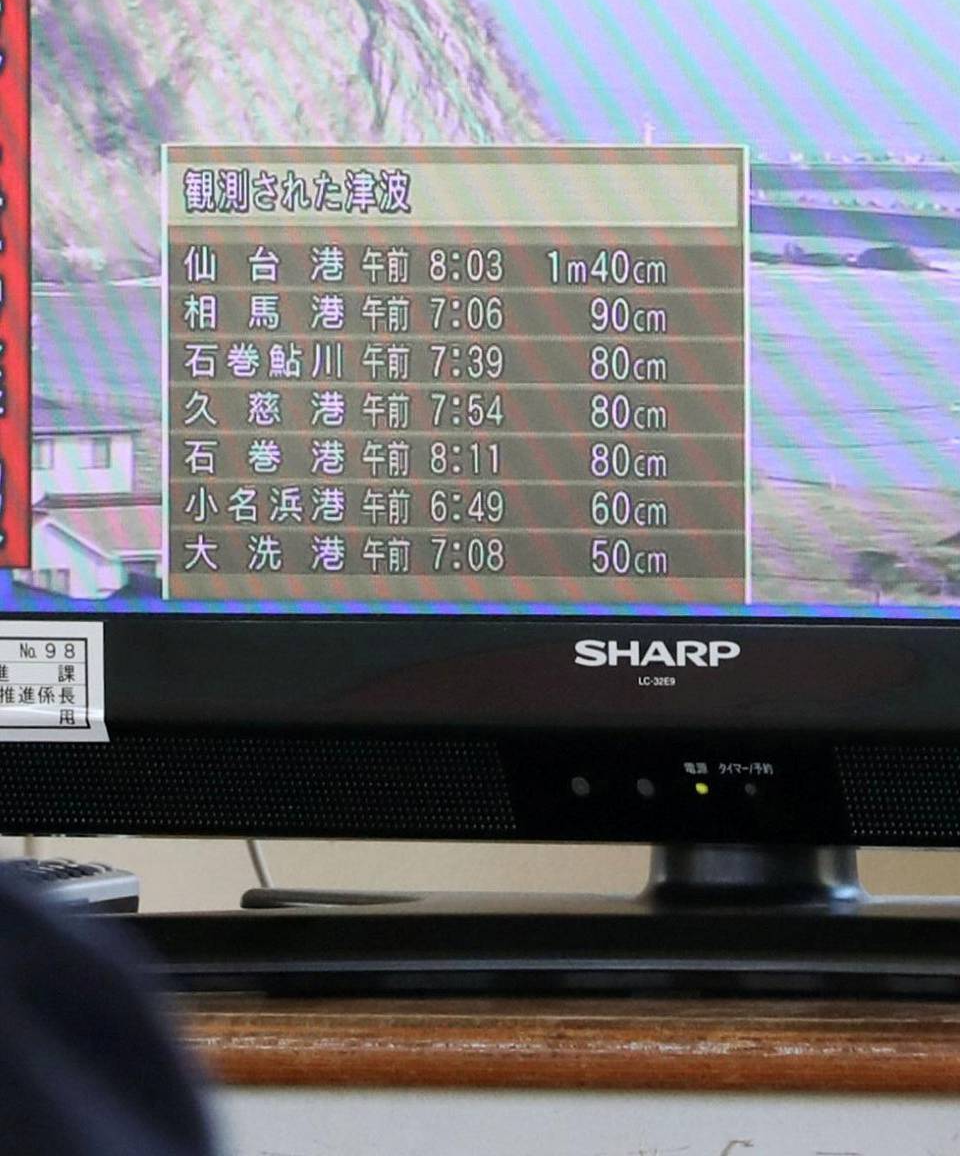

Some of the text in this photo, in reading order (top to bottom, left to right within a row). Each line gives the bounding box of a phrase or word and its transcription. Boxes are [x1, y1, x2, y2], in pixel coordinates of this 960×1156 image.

[183, 169, 412, 215] 観測された津波
[183, 245, 669, 287] 仙台港 午前 8:03 1m40cm
[183, 293, 669, 335] 相馬港 午前 7:06 90cm
[183, 342, 669, 384] 石巻鮎川 午前 7:39 80cm
[183, 390, 669, 432] 久慈港 午前 7:54 80cm
[183, 439, 669, 481] 石巻港 午前 8:11 80cm
[183, 487, 669, 529] 小名浜港 午前 6:49 60cm
[183, 536, 669, 578] 大洗港 午前 7:08 50cm
[574, 639, 742, 668] SHARP
[638, 676, 677, 687] LC-32E9
